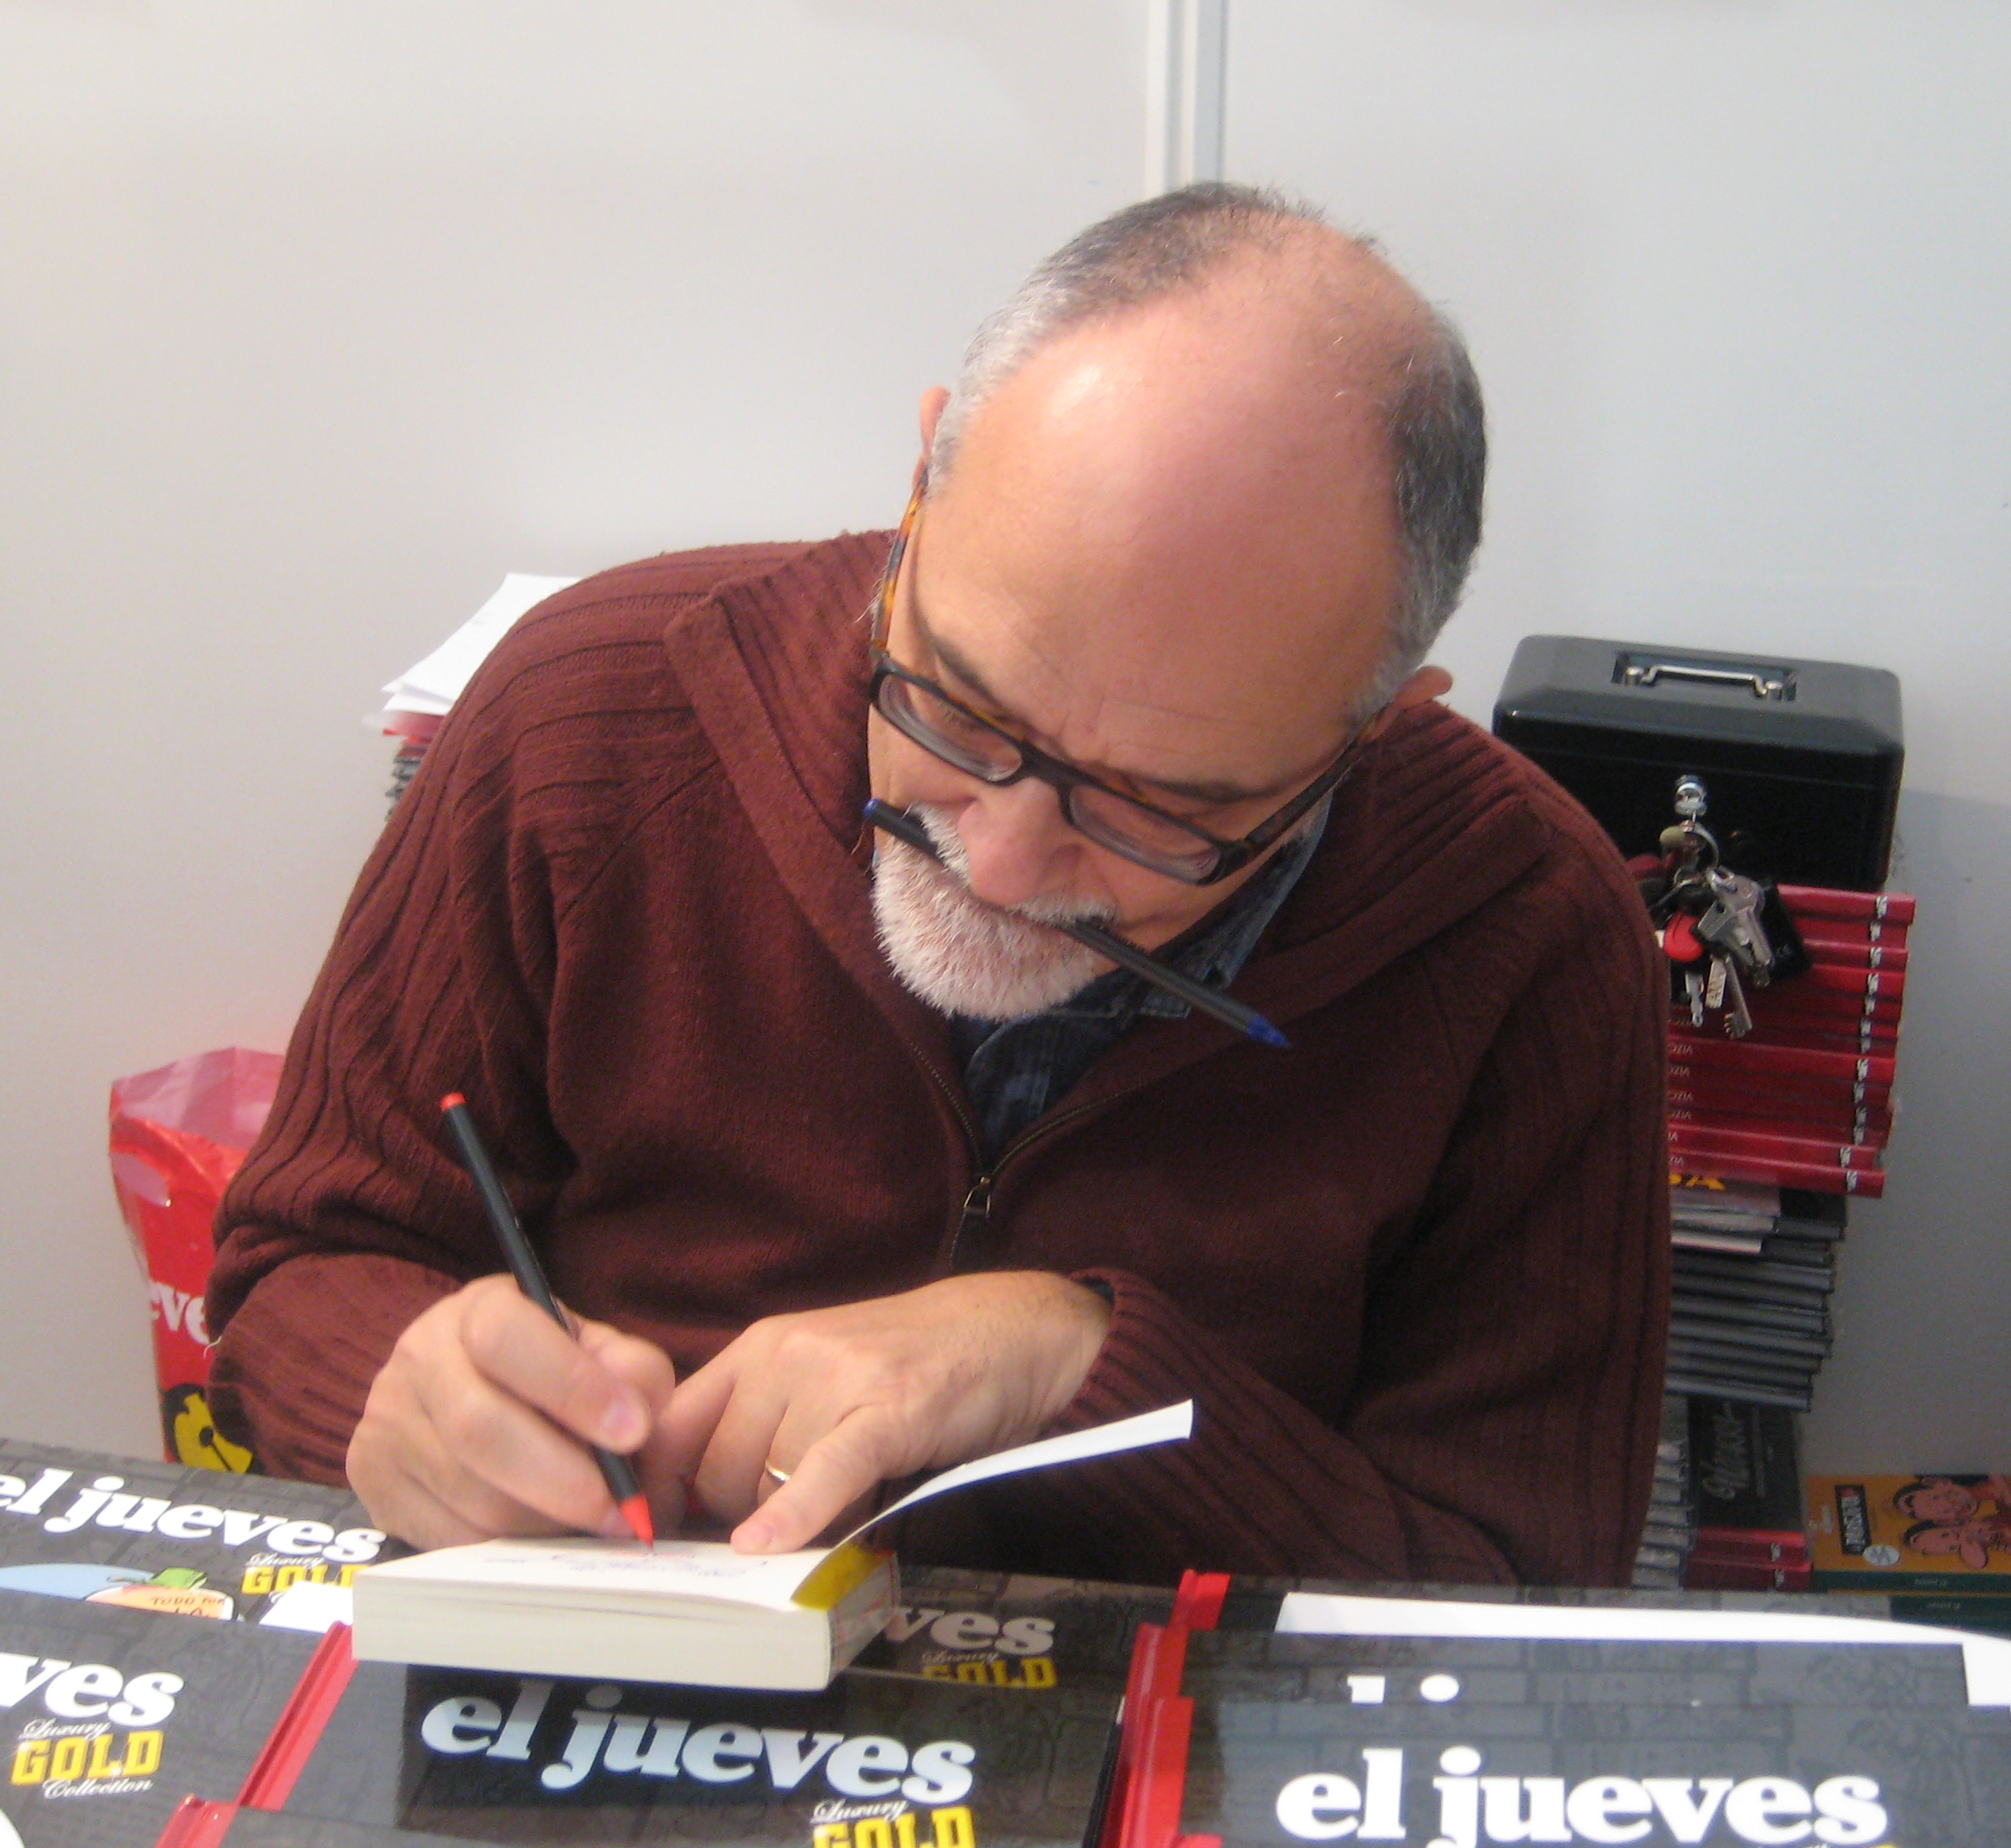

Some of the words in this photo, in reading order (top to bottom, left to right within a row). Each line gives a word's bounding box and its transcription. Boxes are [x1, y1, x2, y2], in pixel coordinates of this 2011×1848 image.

[0, 1467, 74, 1515] el
[43, 1475, 388, 1563] jueves
[17, 1716, 112, 1741] Luxury
[420, 1678, 554, 1760] el
[540, 1683, 976, 1804] jueves
[10, 1729, 165, 1786] GOLD
[42, 1777, 156, 1800] Collection
[810, 1797, 909, 1823] Luxury
[1275, 1747, 1407, 1840] el
[1424, 1745, 1889, 1848] jueves
